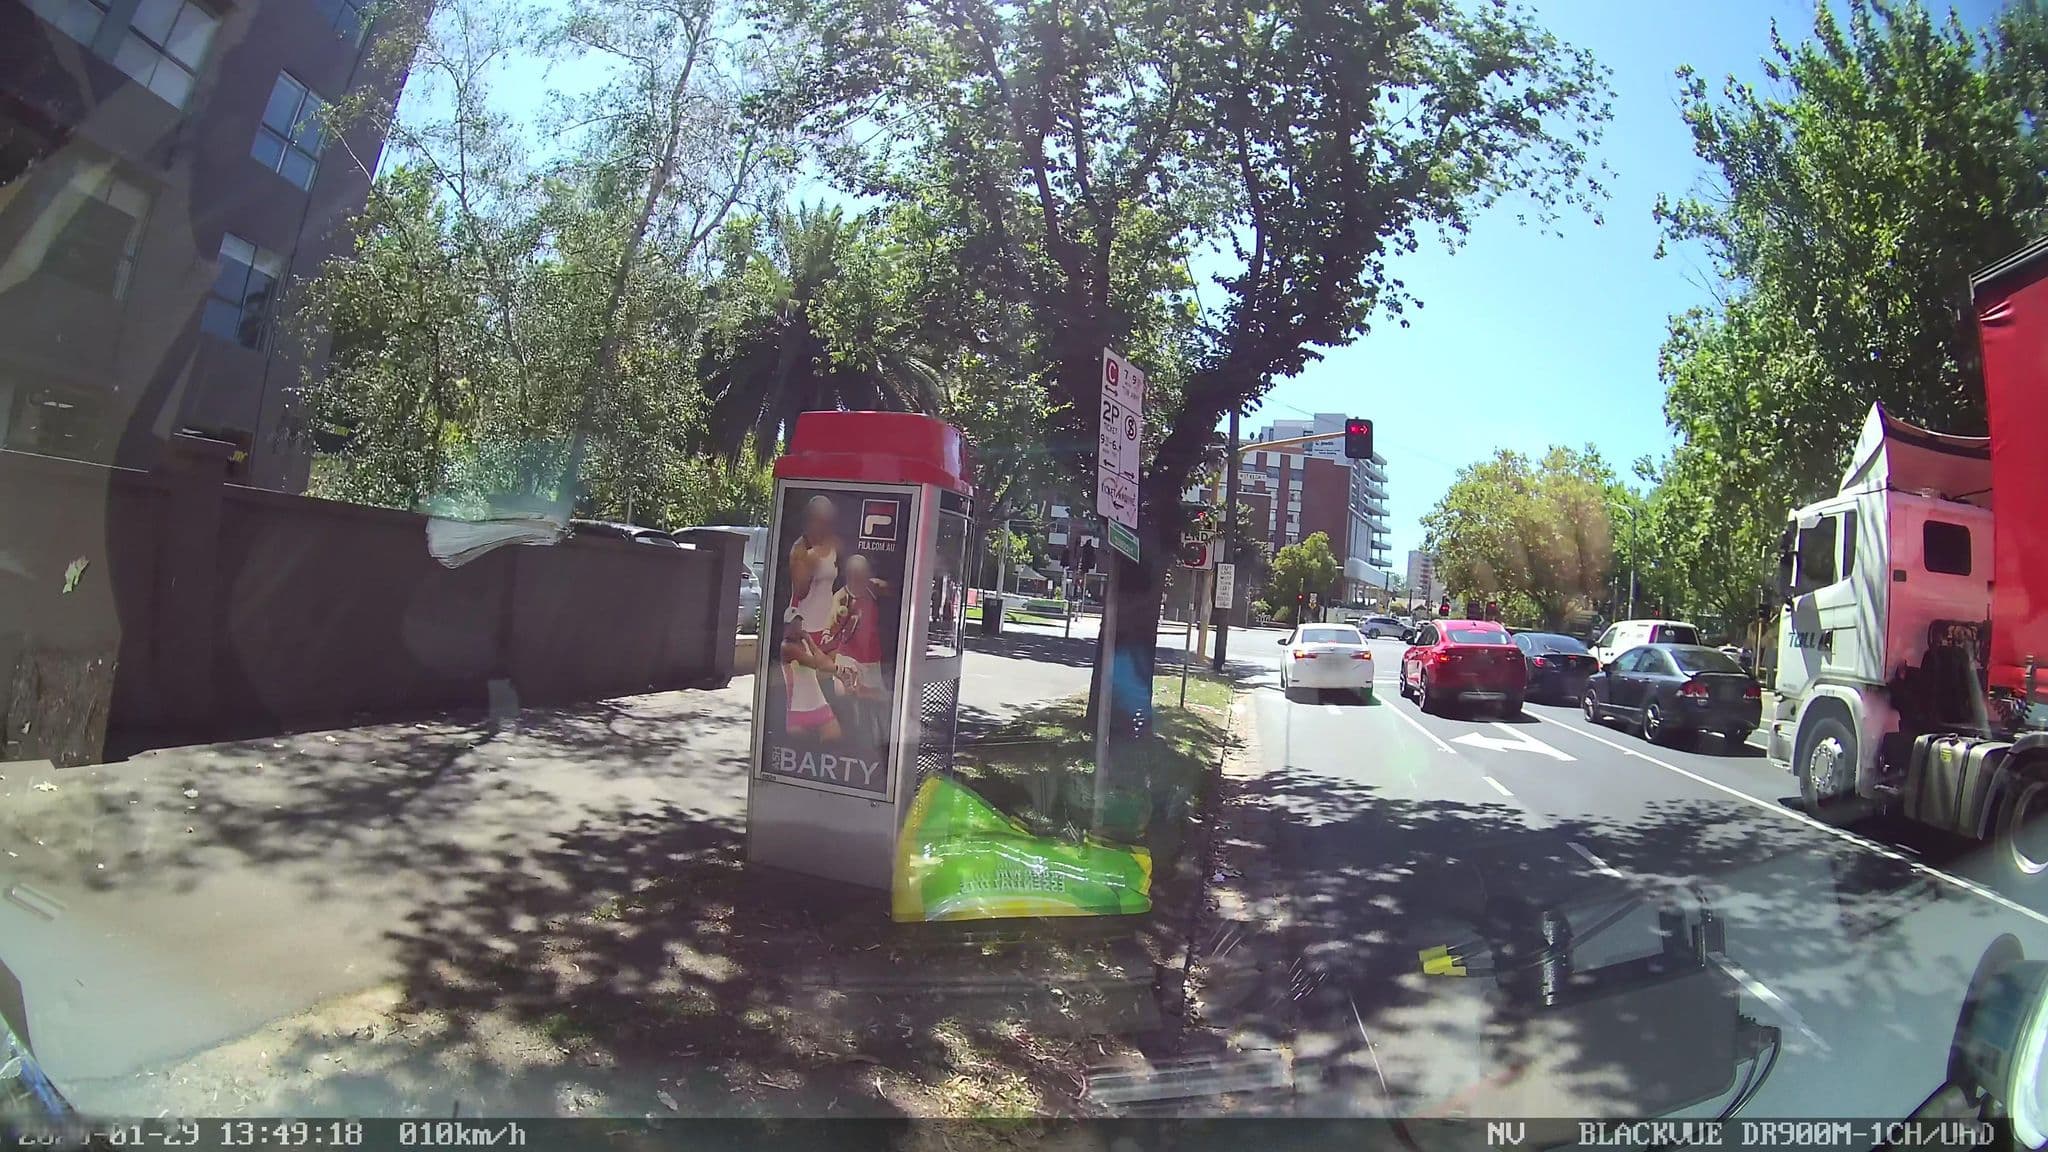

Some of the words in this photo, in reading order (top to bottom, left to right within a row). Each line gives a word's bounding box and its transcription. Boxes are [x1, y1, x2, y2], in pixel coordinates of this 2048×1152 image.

[1103, 400, 1120, 424] 2P
[858, 541, 896, 552] FILA.COM.AU
[1788, 631, 1816, 649] TOLL
[780, 747, 880, 785] BARTY
